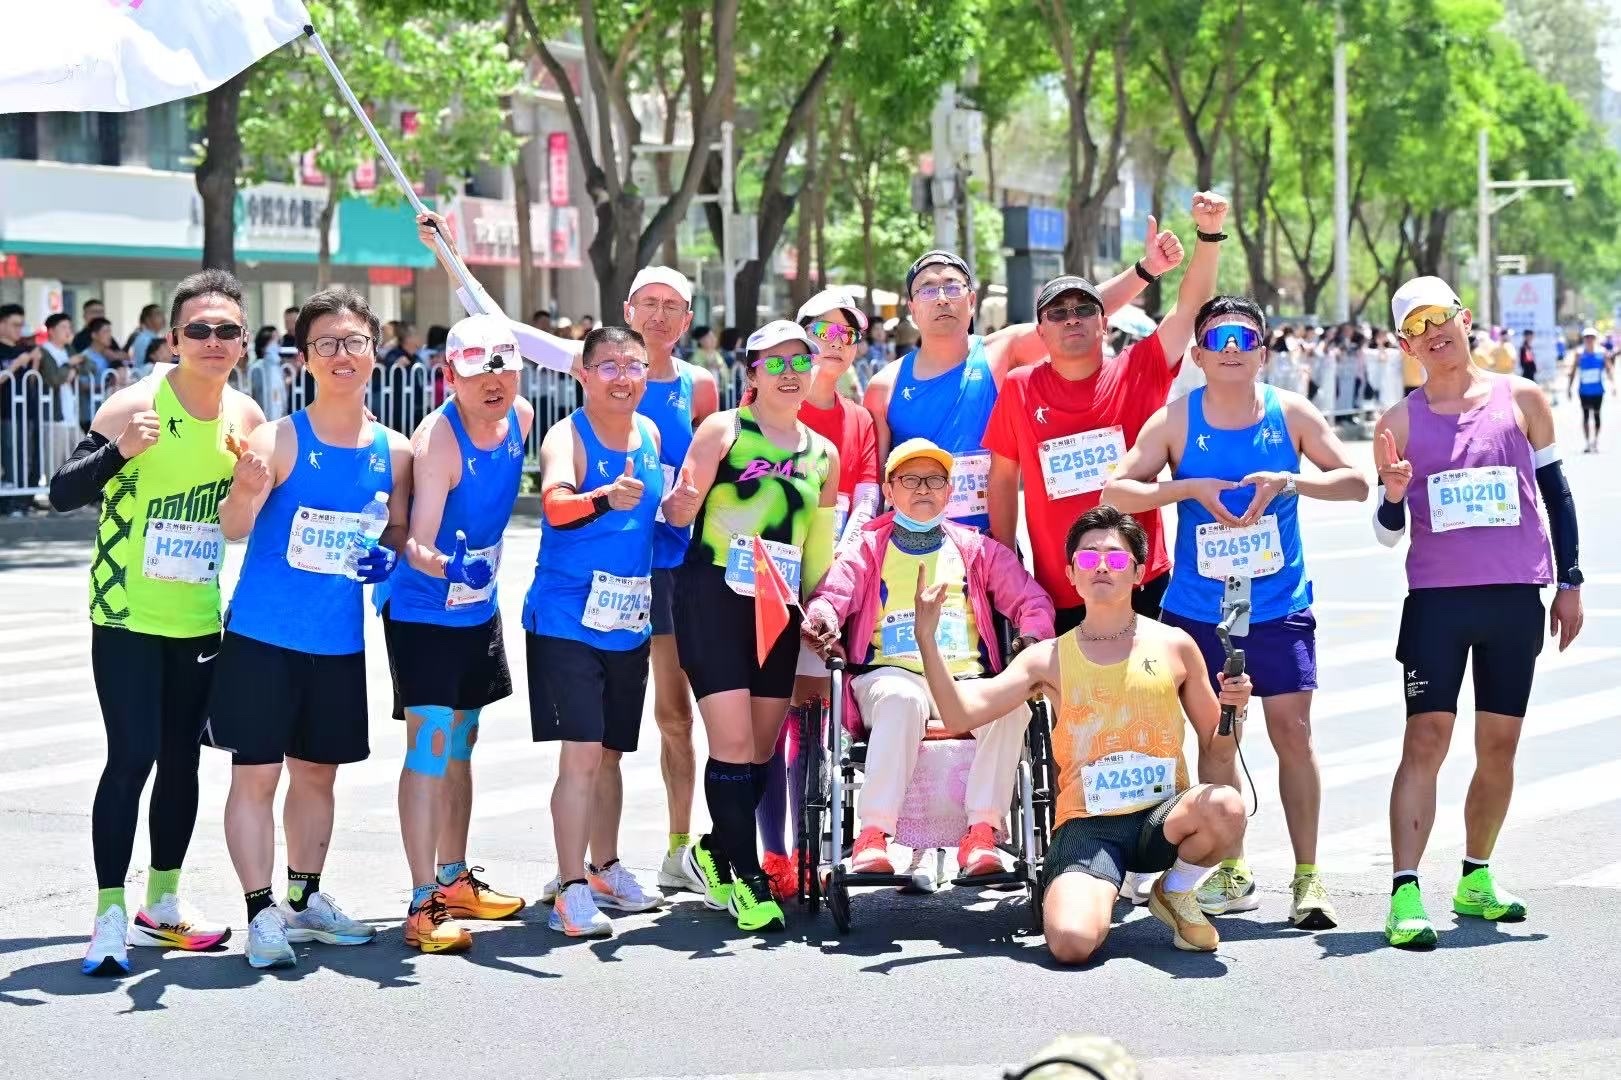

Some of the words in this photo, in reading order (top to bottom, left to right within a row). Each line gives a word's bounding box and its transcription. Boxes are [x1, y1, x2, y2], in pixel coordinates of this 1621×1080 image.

[1049, 444, 1118, 474] E25523
[1440, 483, 1506, 505] B10210
[156, 537, 219, 559] H27403
[1205, 532, 1271, 558] G26597
[1096, 765, 1166, 791] A26309
